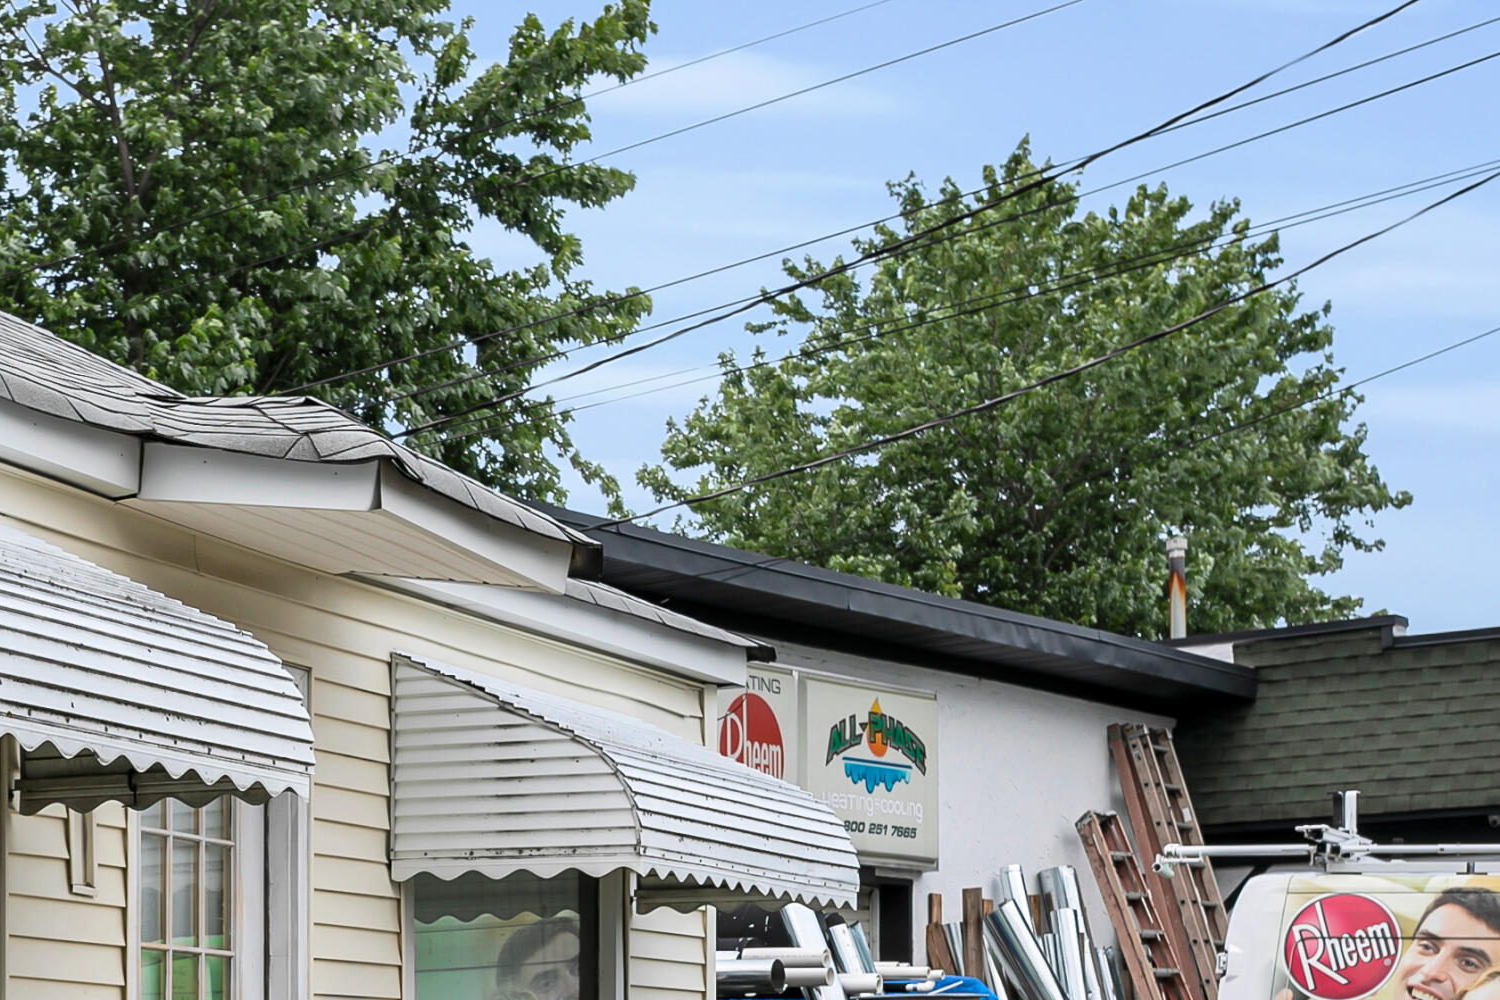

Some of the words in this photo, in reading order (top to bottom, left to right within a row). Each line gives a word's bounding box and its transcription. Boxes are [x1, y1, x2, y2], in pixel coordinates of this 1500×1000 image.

[745, 674, 781, 695] TING
[868, 822, 888, 836] 251
[1291, 900, 1397, 991] Rheem
